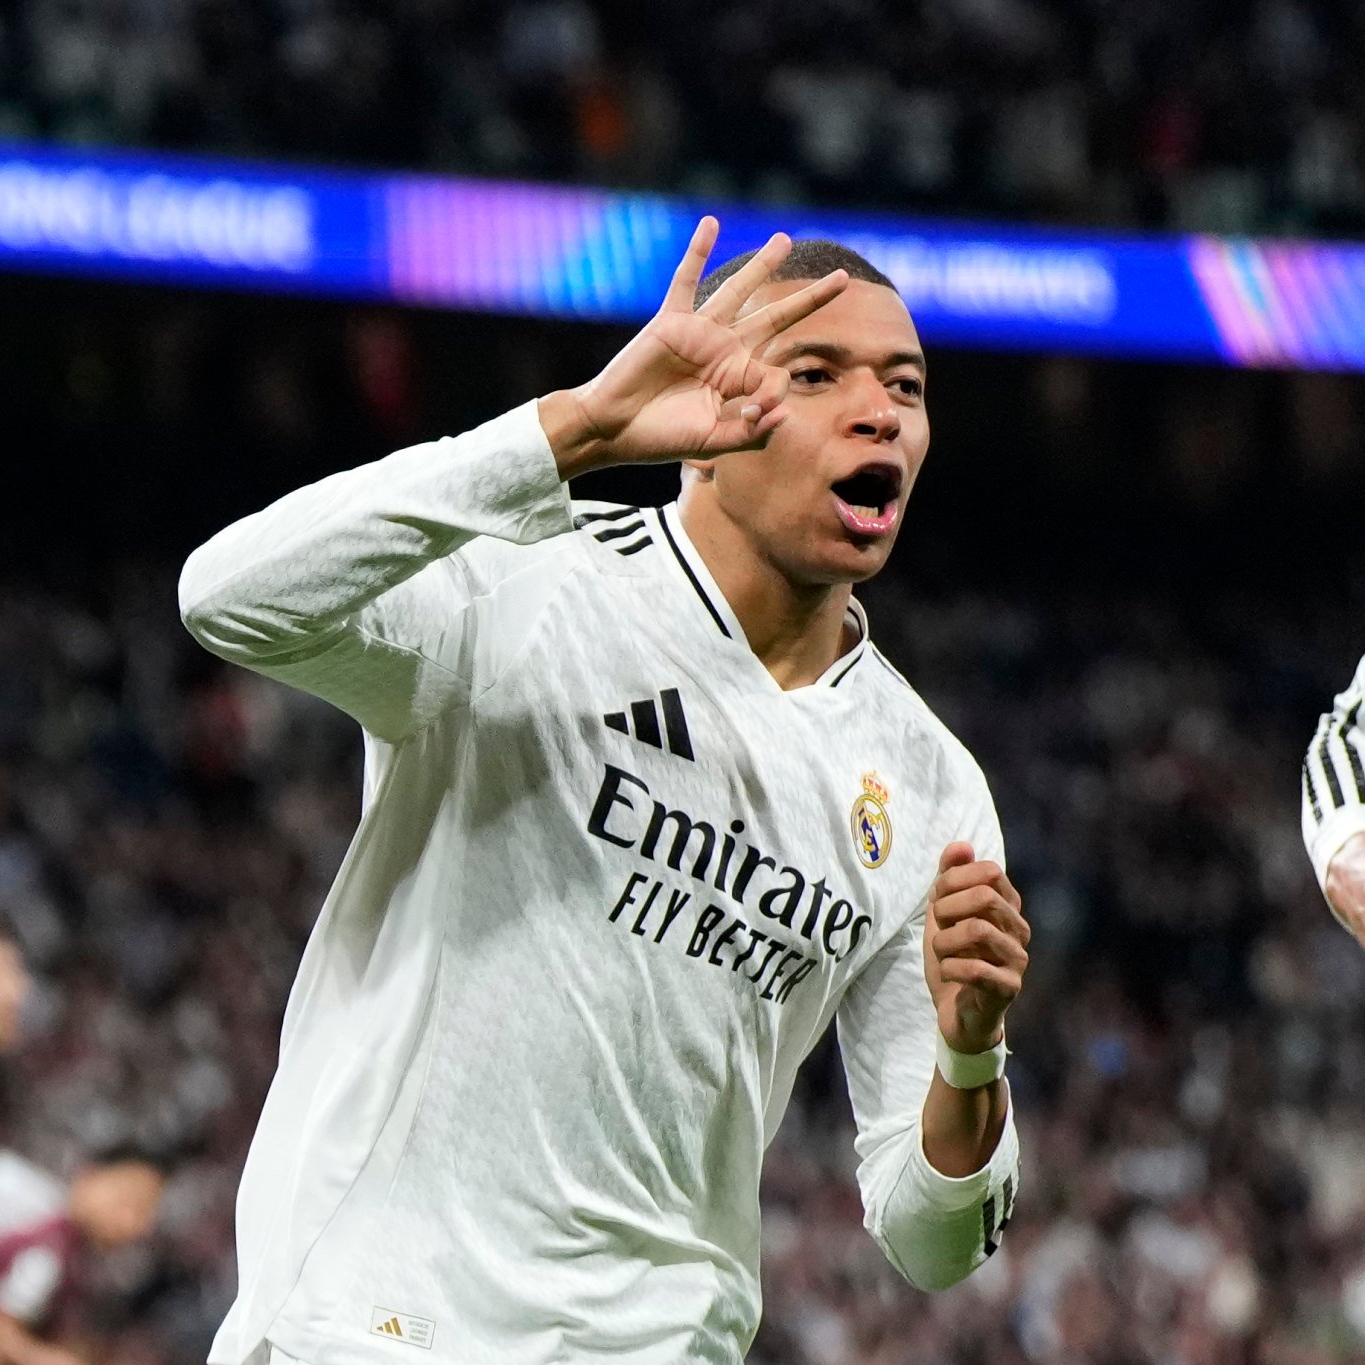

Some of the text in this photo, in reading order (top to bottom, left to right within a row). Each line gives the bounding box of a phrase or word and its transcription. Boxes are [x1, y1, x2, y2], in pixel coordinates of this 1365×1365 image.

[587, 762, 873, 964] Emirates
[608, 871, 819, 1005] FLY BETTER
